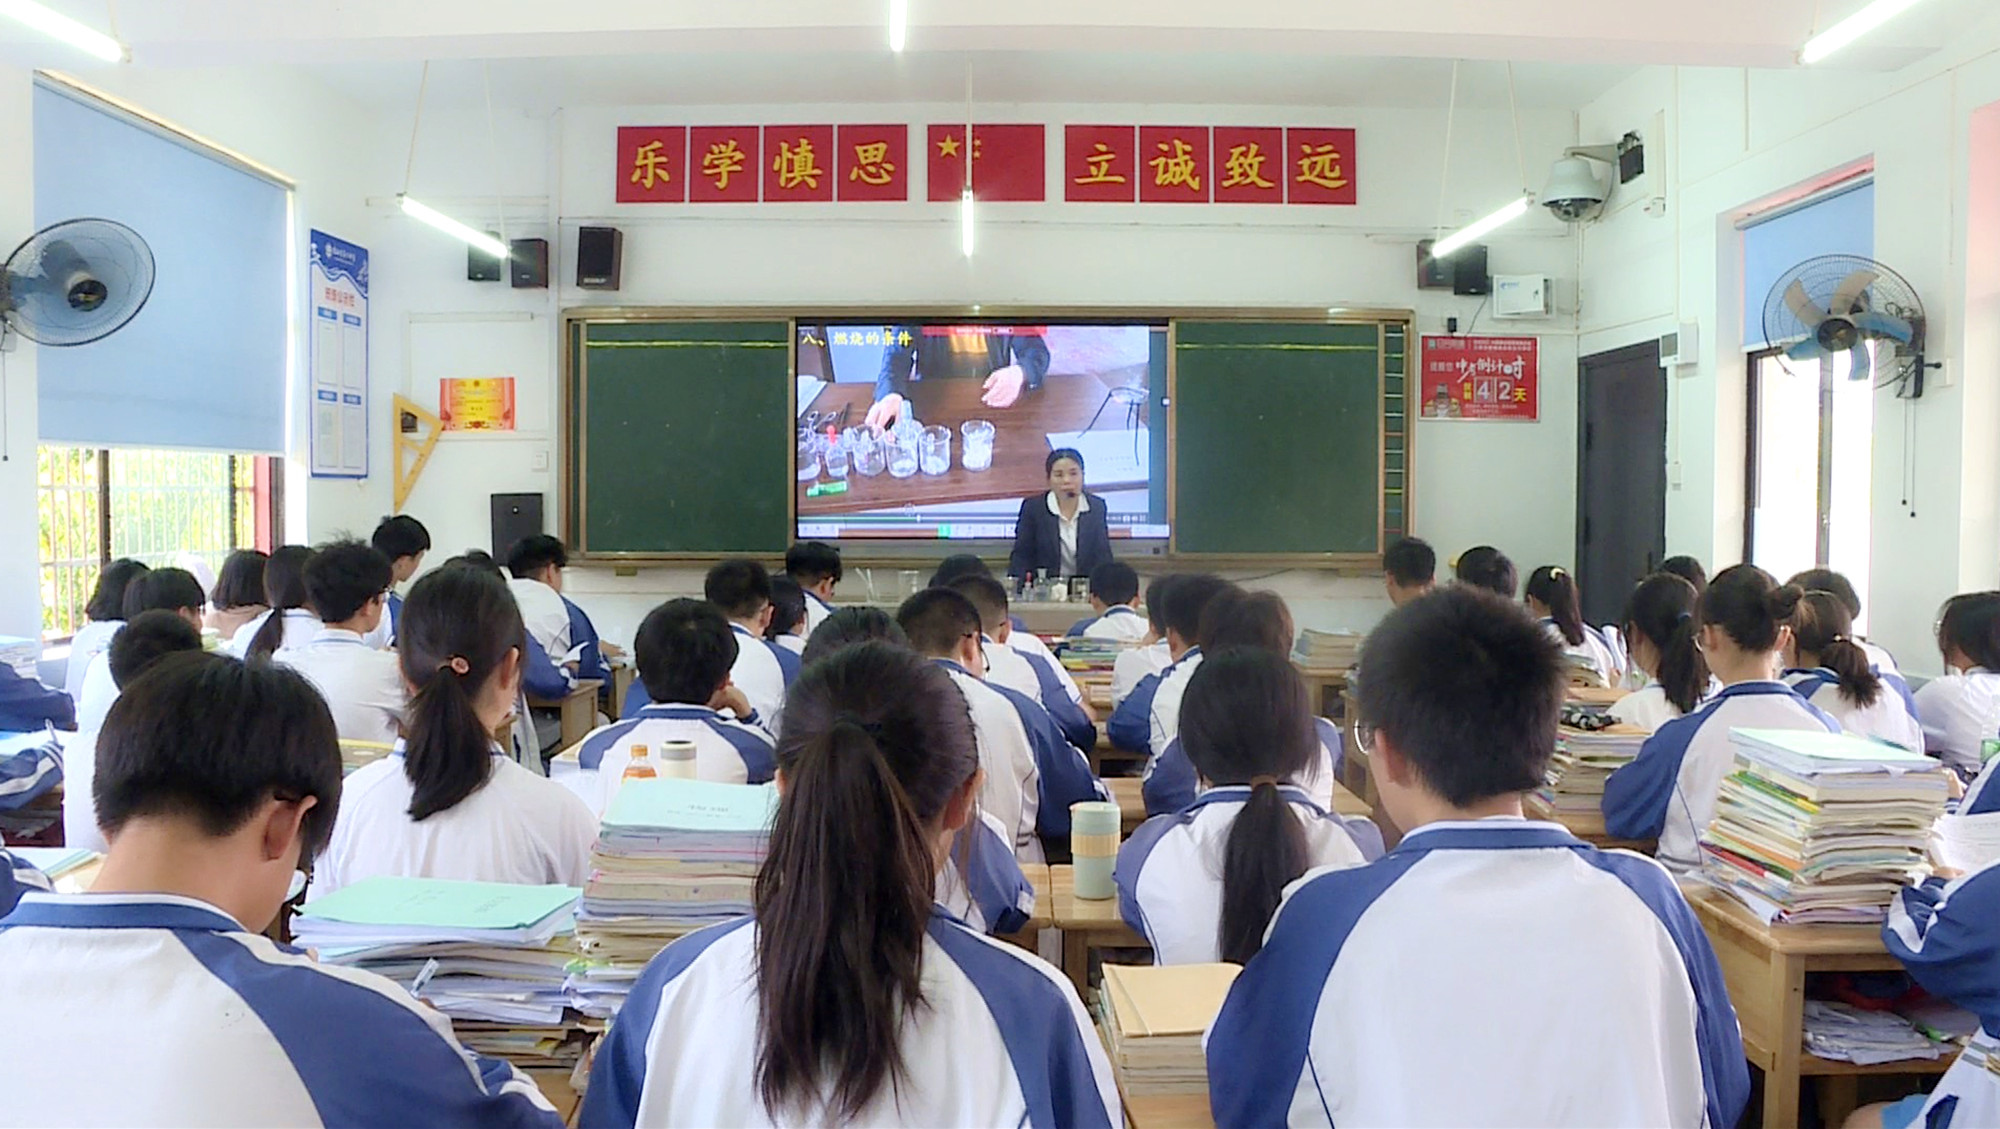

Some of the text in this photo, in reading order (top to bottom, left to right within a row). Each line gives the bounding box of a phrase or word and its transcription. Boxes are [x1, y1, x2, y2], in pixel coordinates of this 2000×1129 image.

[630, 137, 896, 191] 乐学慎思
[1074, 138, 1349, 190] 立诚致远
[801, 330, 913, 348] 八、燃烧的条件
